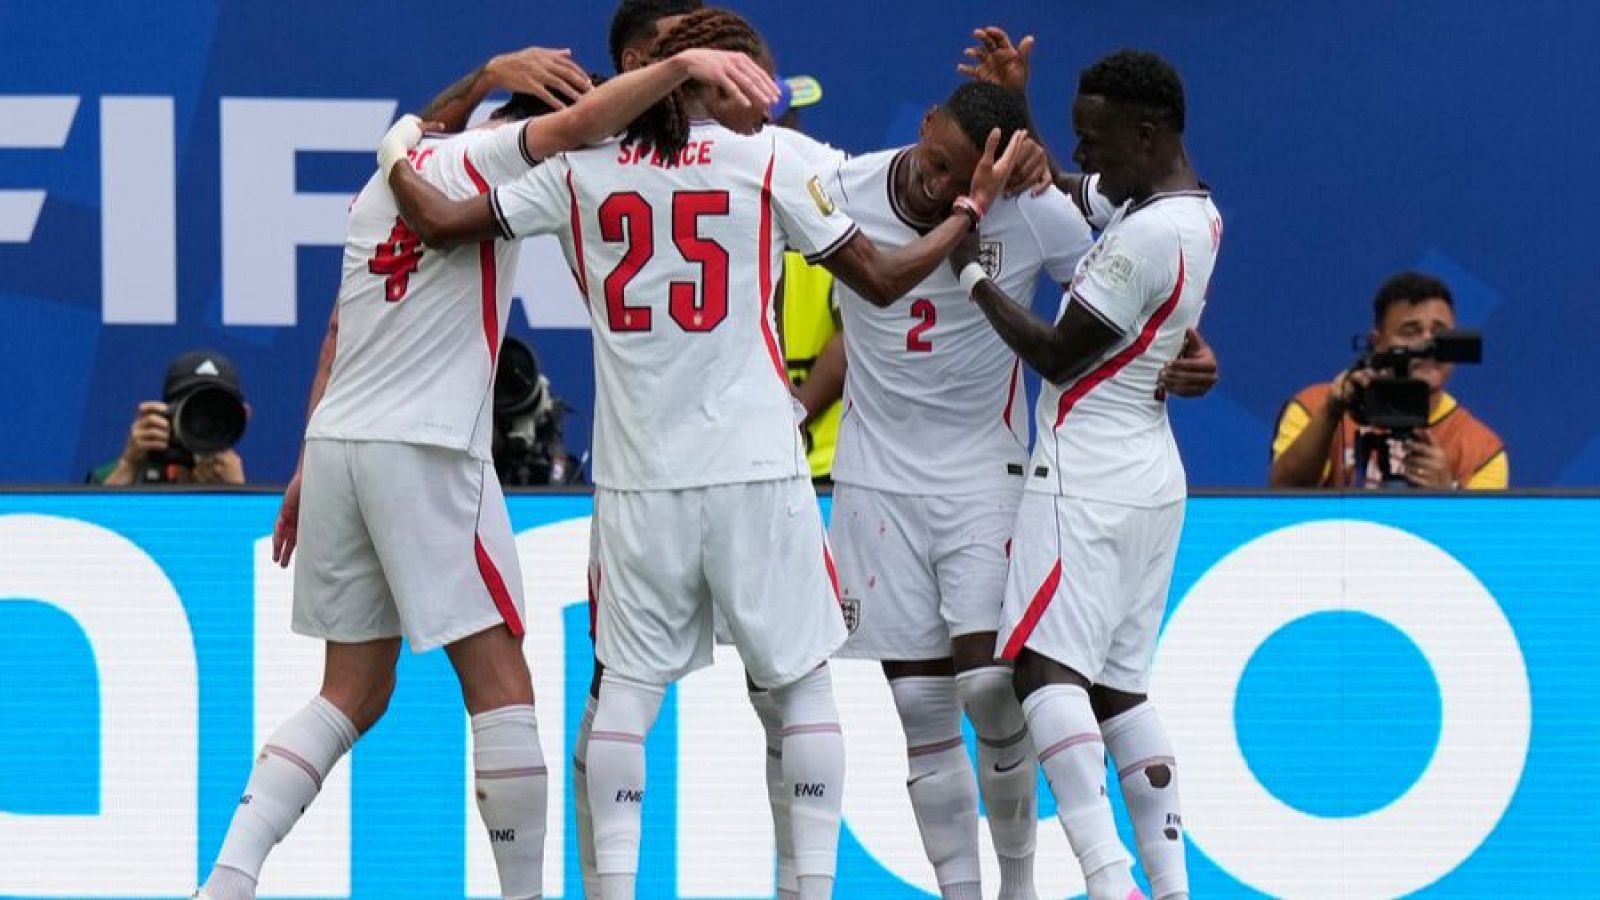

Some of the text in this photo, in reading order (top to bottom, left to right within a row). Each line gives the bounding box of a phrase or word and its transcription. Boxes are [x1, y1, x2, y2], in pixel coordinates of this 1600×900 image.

[0, 95, 592, 328] IF
[368, 215, 424, 302] 4
[598, 189, 730, 333] 25
[906, 298, 936, 353] 2
[794, 783, 826, 798] ENG
[1165, 812, 1181, 826] EN
